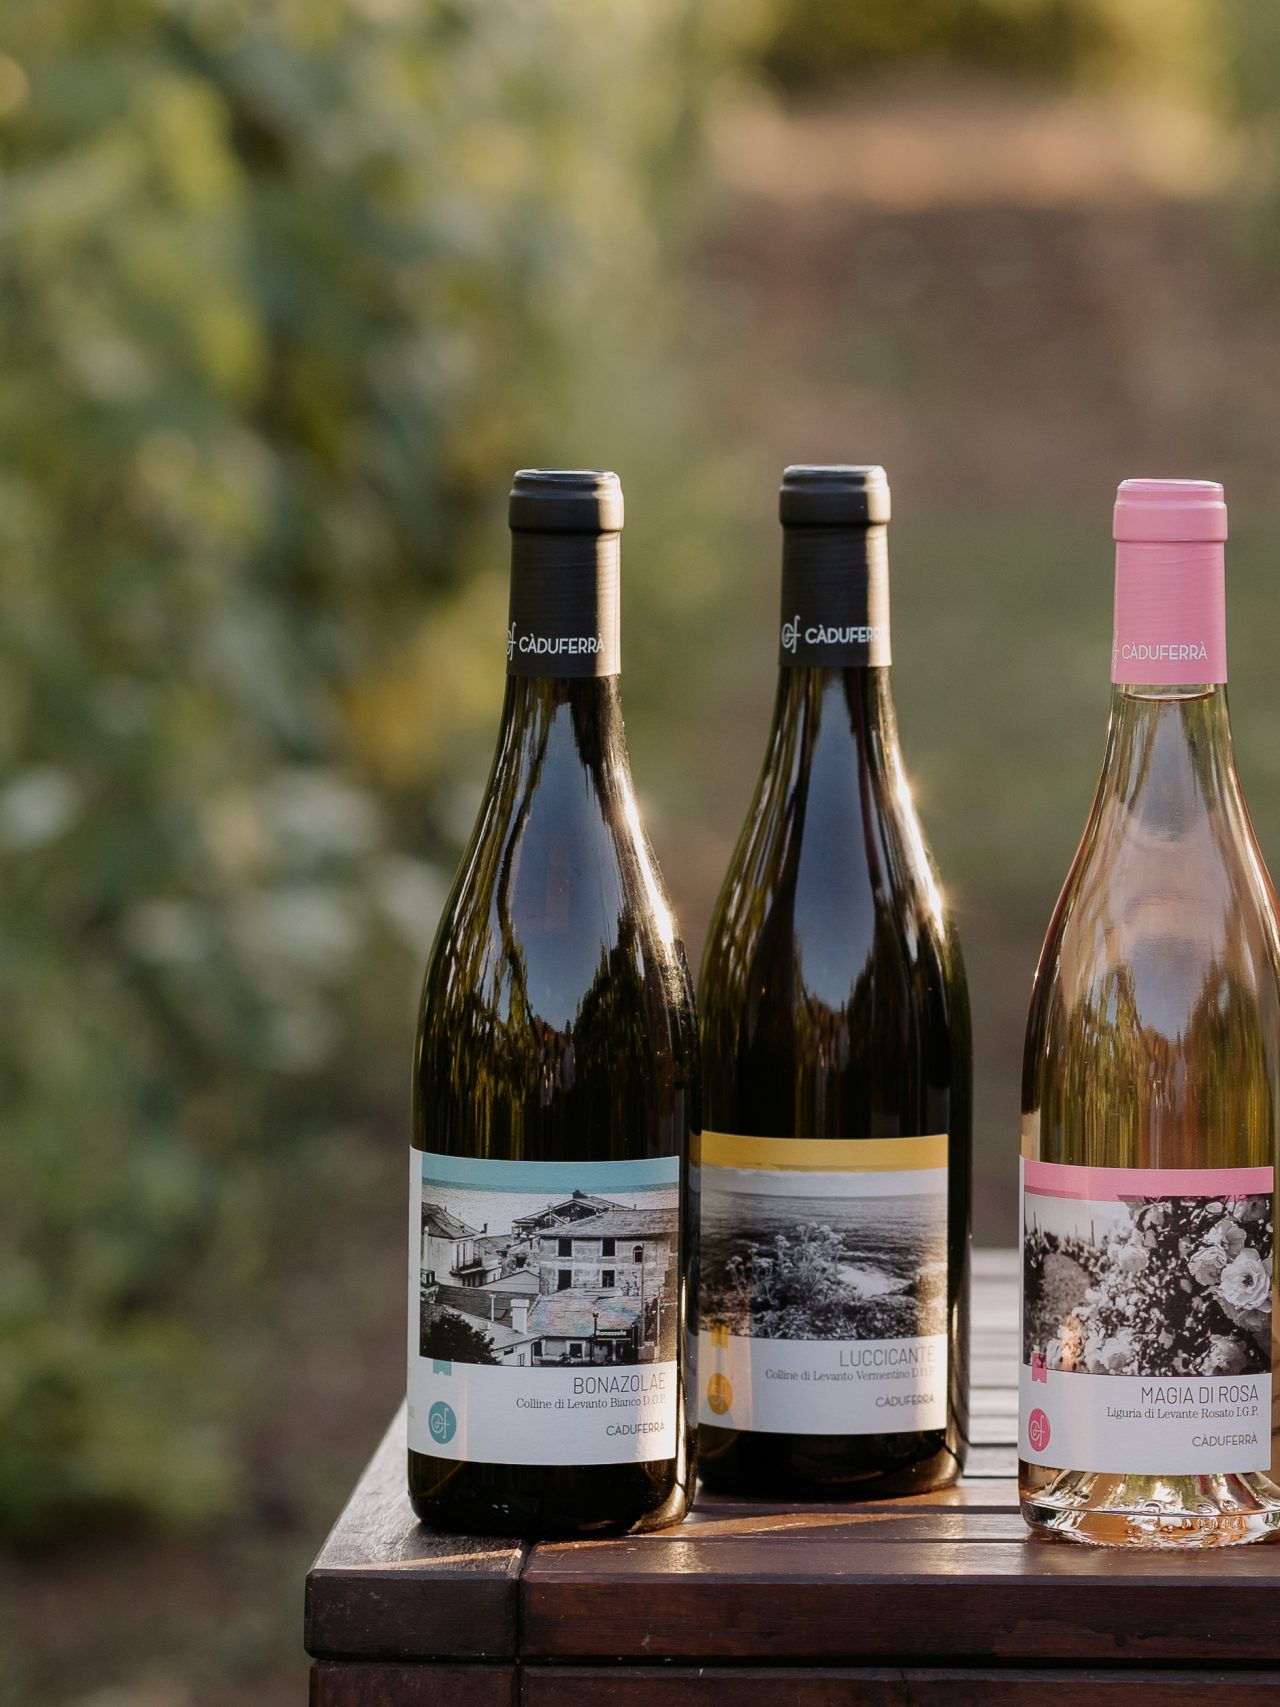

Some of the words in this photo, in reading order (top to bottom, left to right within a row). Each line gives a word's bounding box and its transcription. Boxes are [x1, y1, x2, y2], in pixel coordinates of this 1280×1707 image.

[518, 632, 605, 655] CÀDUFERRÀ
[804, 623, 885, 645] CÀDUFERR
[1121, 640, 1208, 661] CÀDUFERRÀ
[839, 1345, 935, 1367] LUCCICANTE
[573, 1372, 666, 1395] BONAZOLAE
[765, 1368, 798, 1380] Colline
[801, 1369, 810, 1380] di
[813, 1370, 854, 1382] Levanto
[856, 1369, 910, 1381] Vermentino
[516, 1397, 552, 1410] Colline
[554, 1397, 565, 1409] di
[567, 1397, 608, 1410] Levanto
[610, 1396, 642, 1409] Bianco
[1141, 1386, 1195, 1405] MAGIA
[1198, 1385, 1214, 1404] DI
[1218, 1384, 1259, 1403] ROSA
[1106, 1406, 1142, 1419] Liguria
[1144, 1406, 1155, 1419] di
[1157, 1407, 1199, 1419] Levante
[1201, 1407, 1235, 1419] Rosato
[1192, 1433, 1258, 1448] CÀDUFERRÀ
